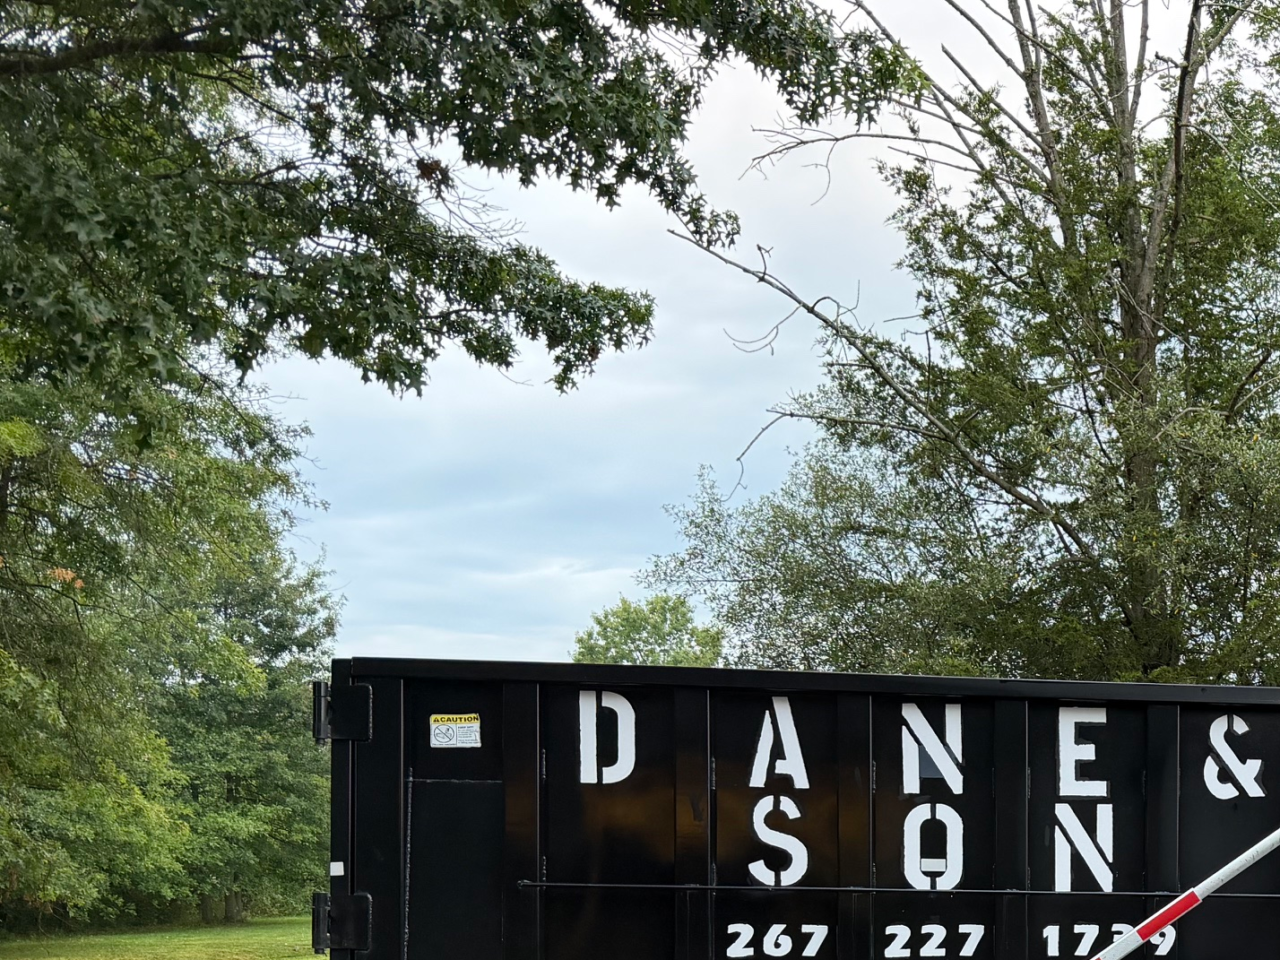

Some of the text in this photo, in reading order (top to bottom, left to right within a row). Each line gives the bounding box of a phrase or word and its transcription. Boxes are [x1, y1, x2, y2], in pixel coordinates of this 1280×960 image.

[1203, 714, 1266, 800] &
[726, 923, 829, 958] 267
[884, 924, 985, 958] 227
